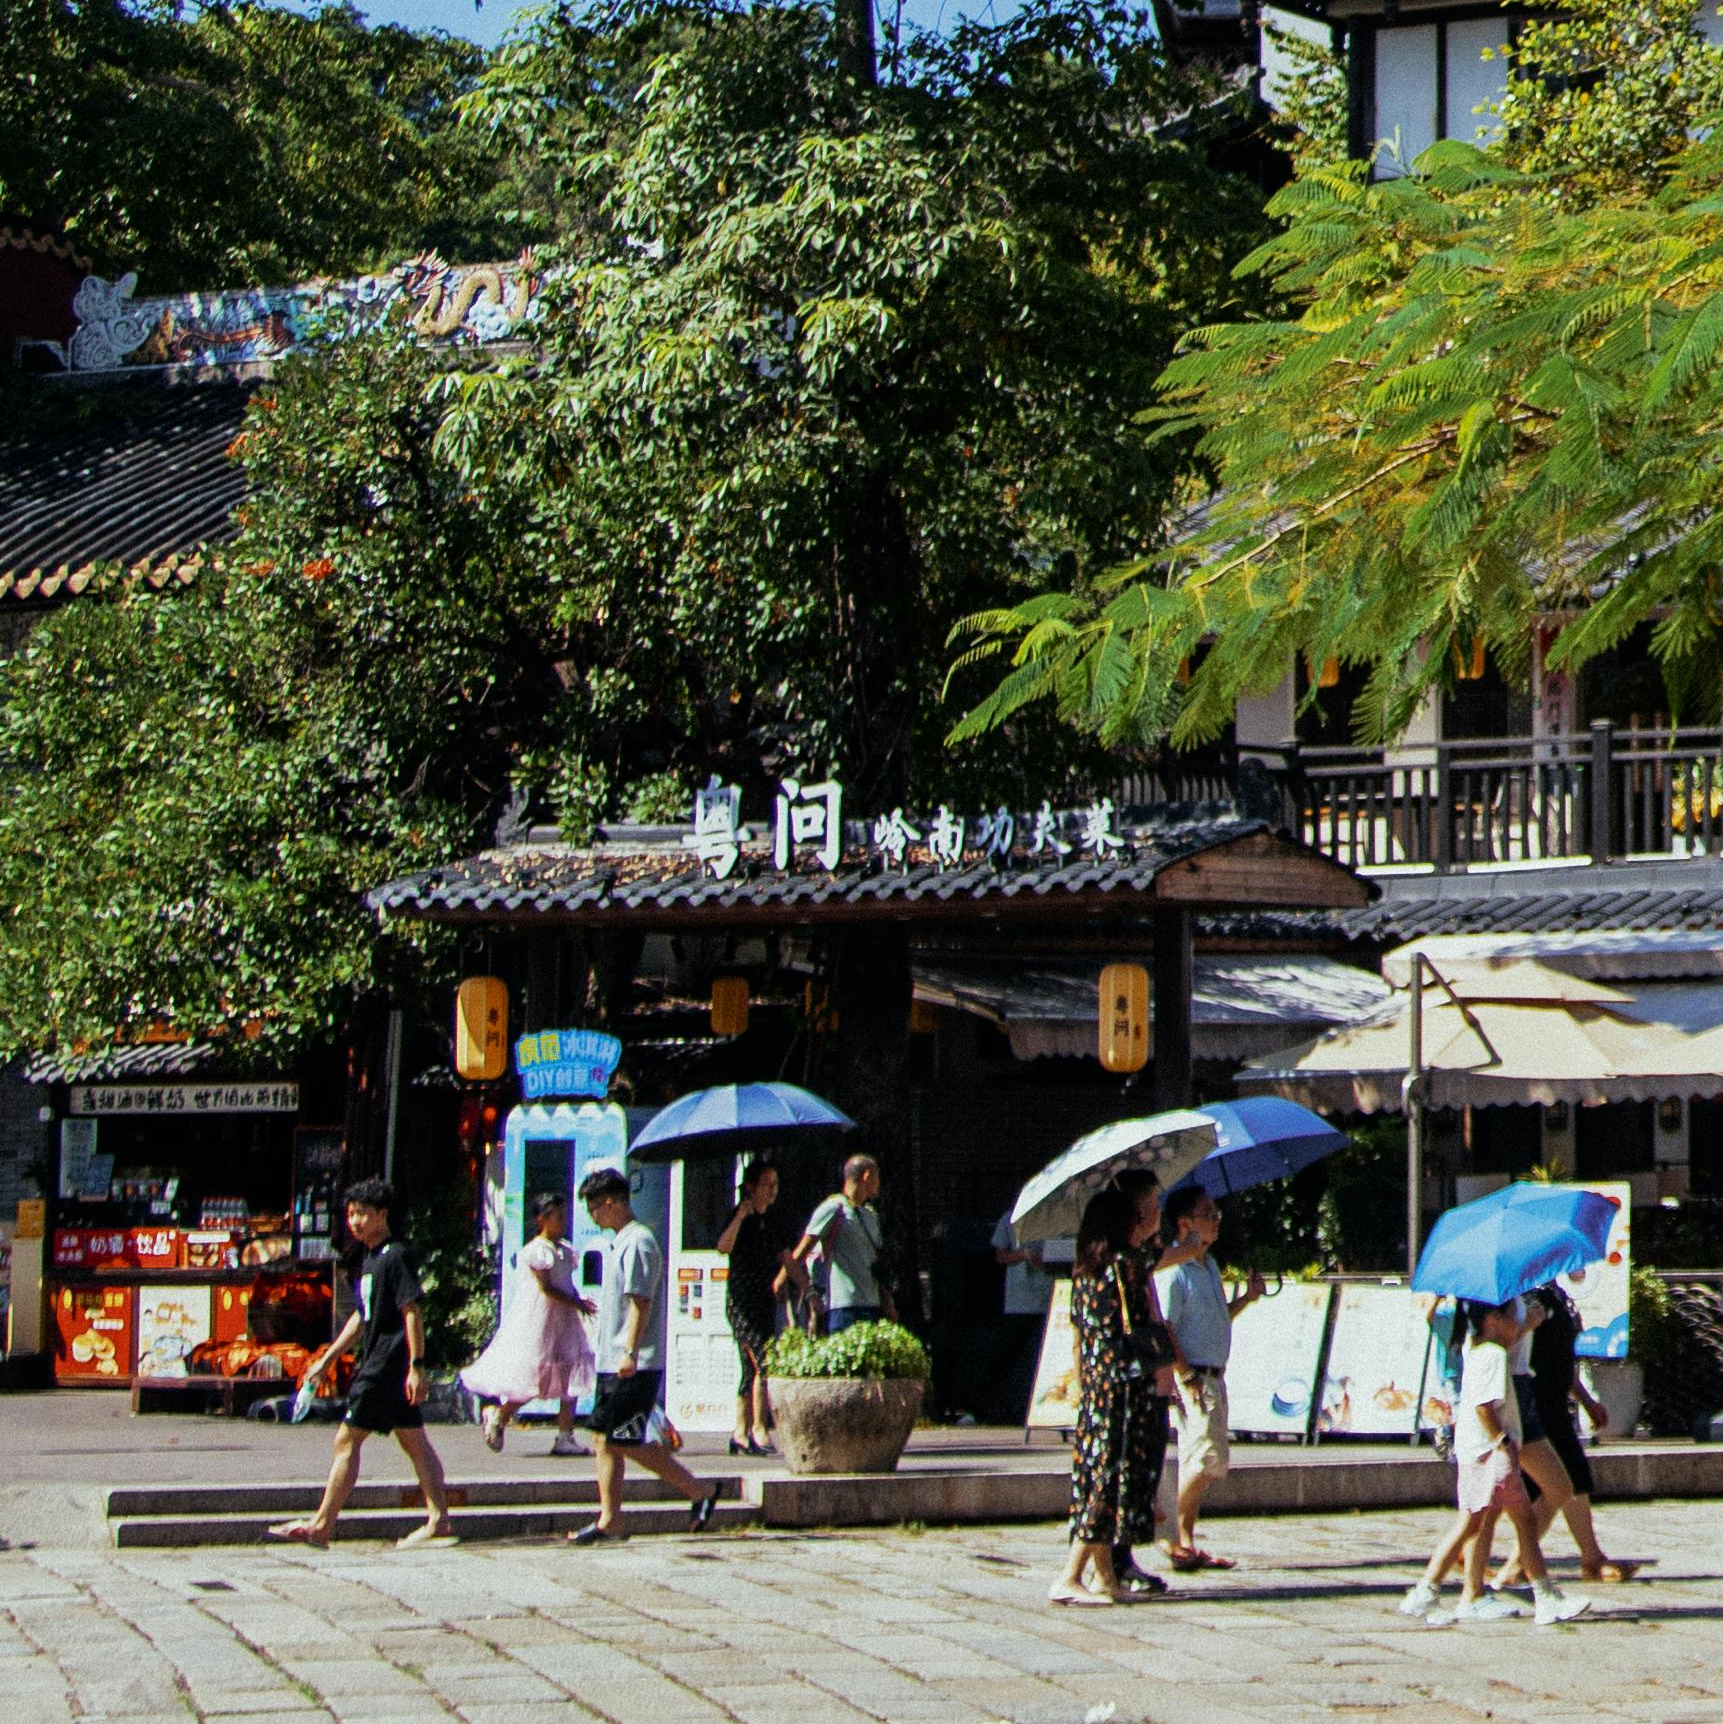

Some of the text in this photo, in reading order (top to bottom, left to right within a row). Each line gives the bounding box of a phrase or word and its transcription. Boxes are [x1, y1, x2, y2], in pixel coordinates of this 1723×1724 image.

[682, 775, 1125, 879] 粤问 岭南功夫菜
